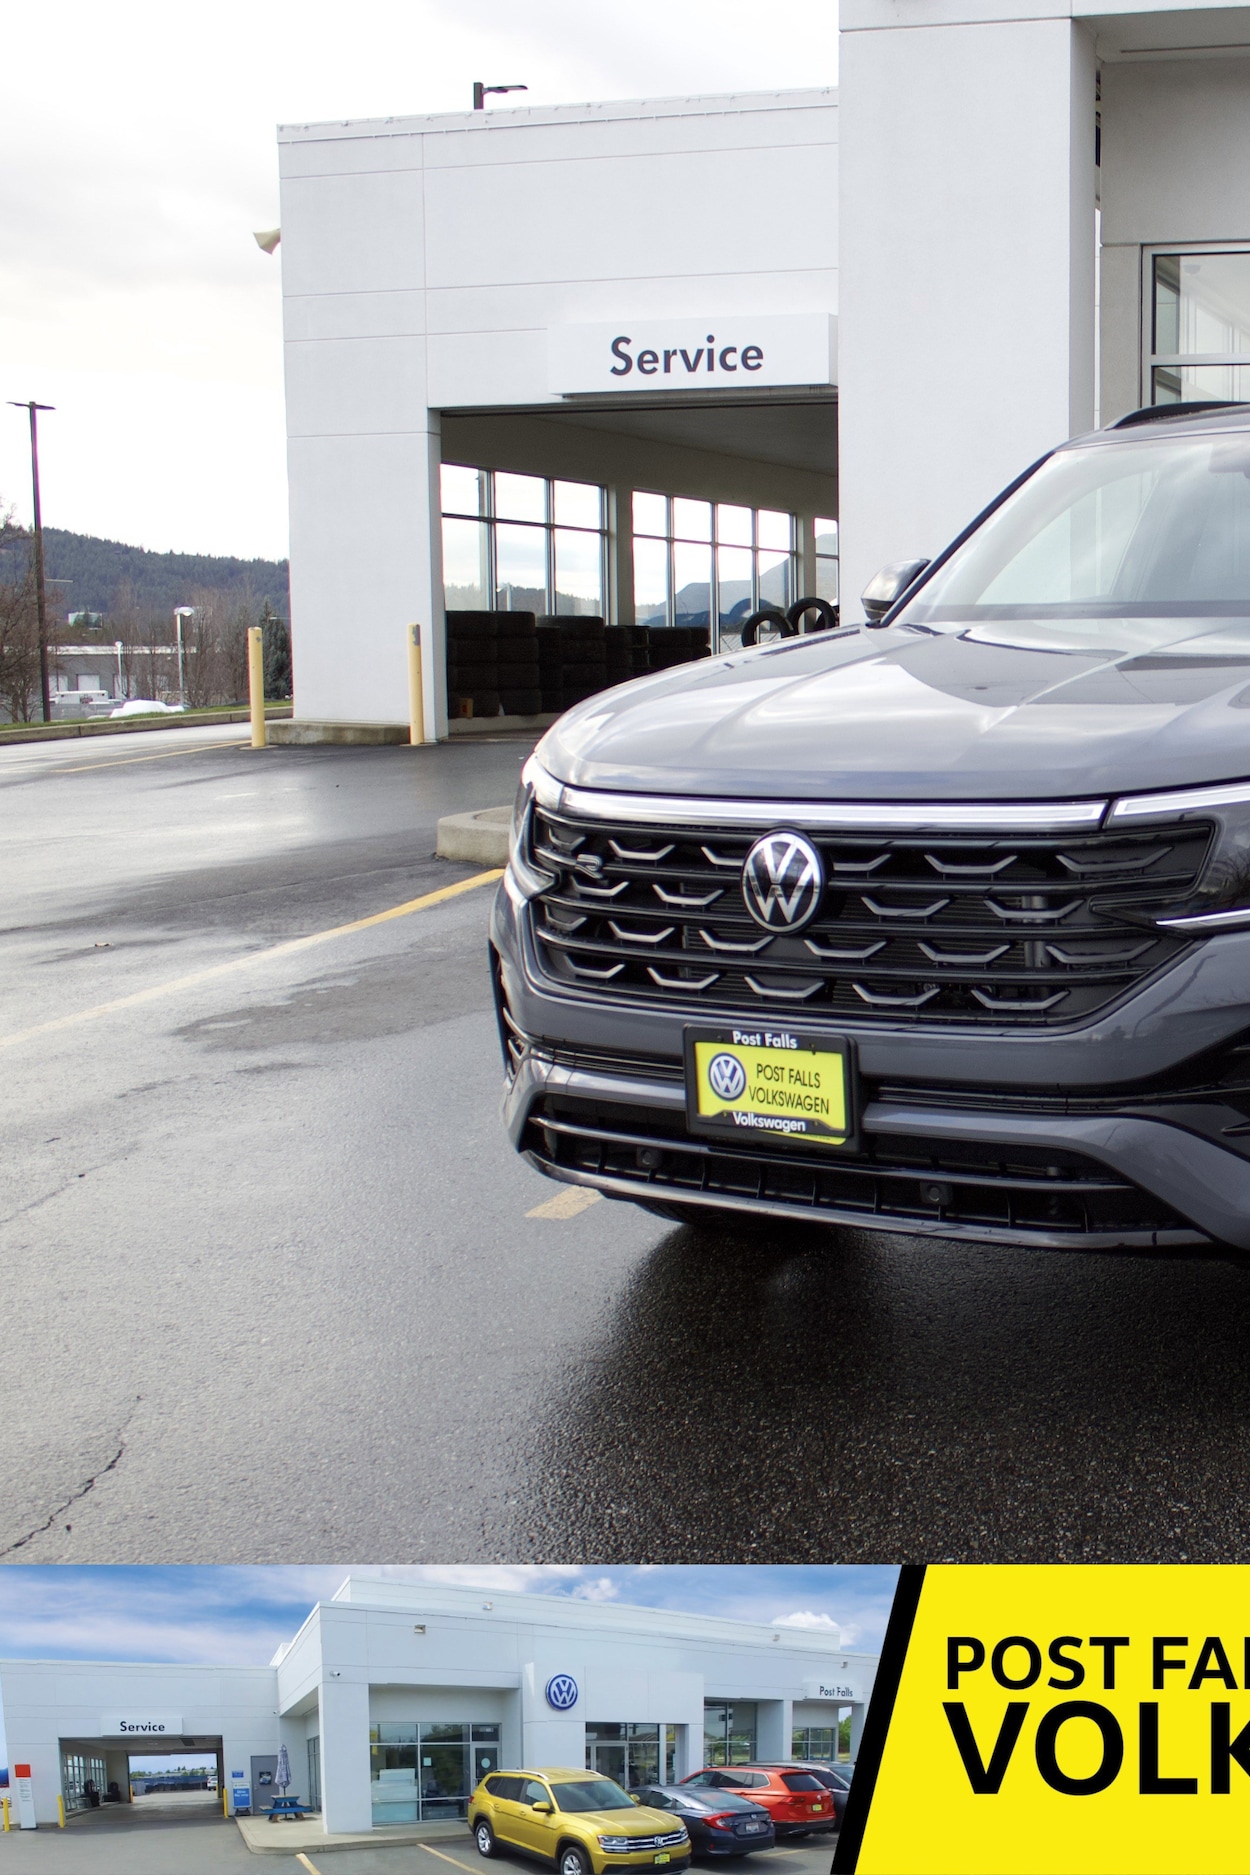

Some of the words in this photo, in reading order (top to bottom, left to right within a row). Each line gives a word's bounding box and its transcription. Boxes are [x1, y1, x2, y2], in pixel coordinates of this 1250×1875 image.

[610, 334, 764, 376] Service
[732, 1030, 761, 1046] Post
[764, 1032, 798, 1049] Falls
[756, 1063, 785, 1082] POST
[788, 1068, 821, 1089] FALLS
[748, 1085, 830, 1115] VOLKSWAGEN
[732, 1112, 806, 1133] Volkswagen
